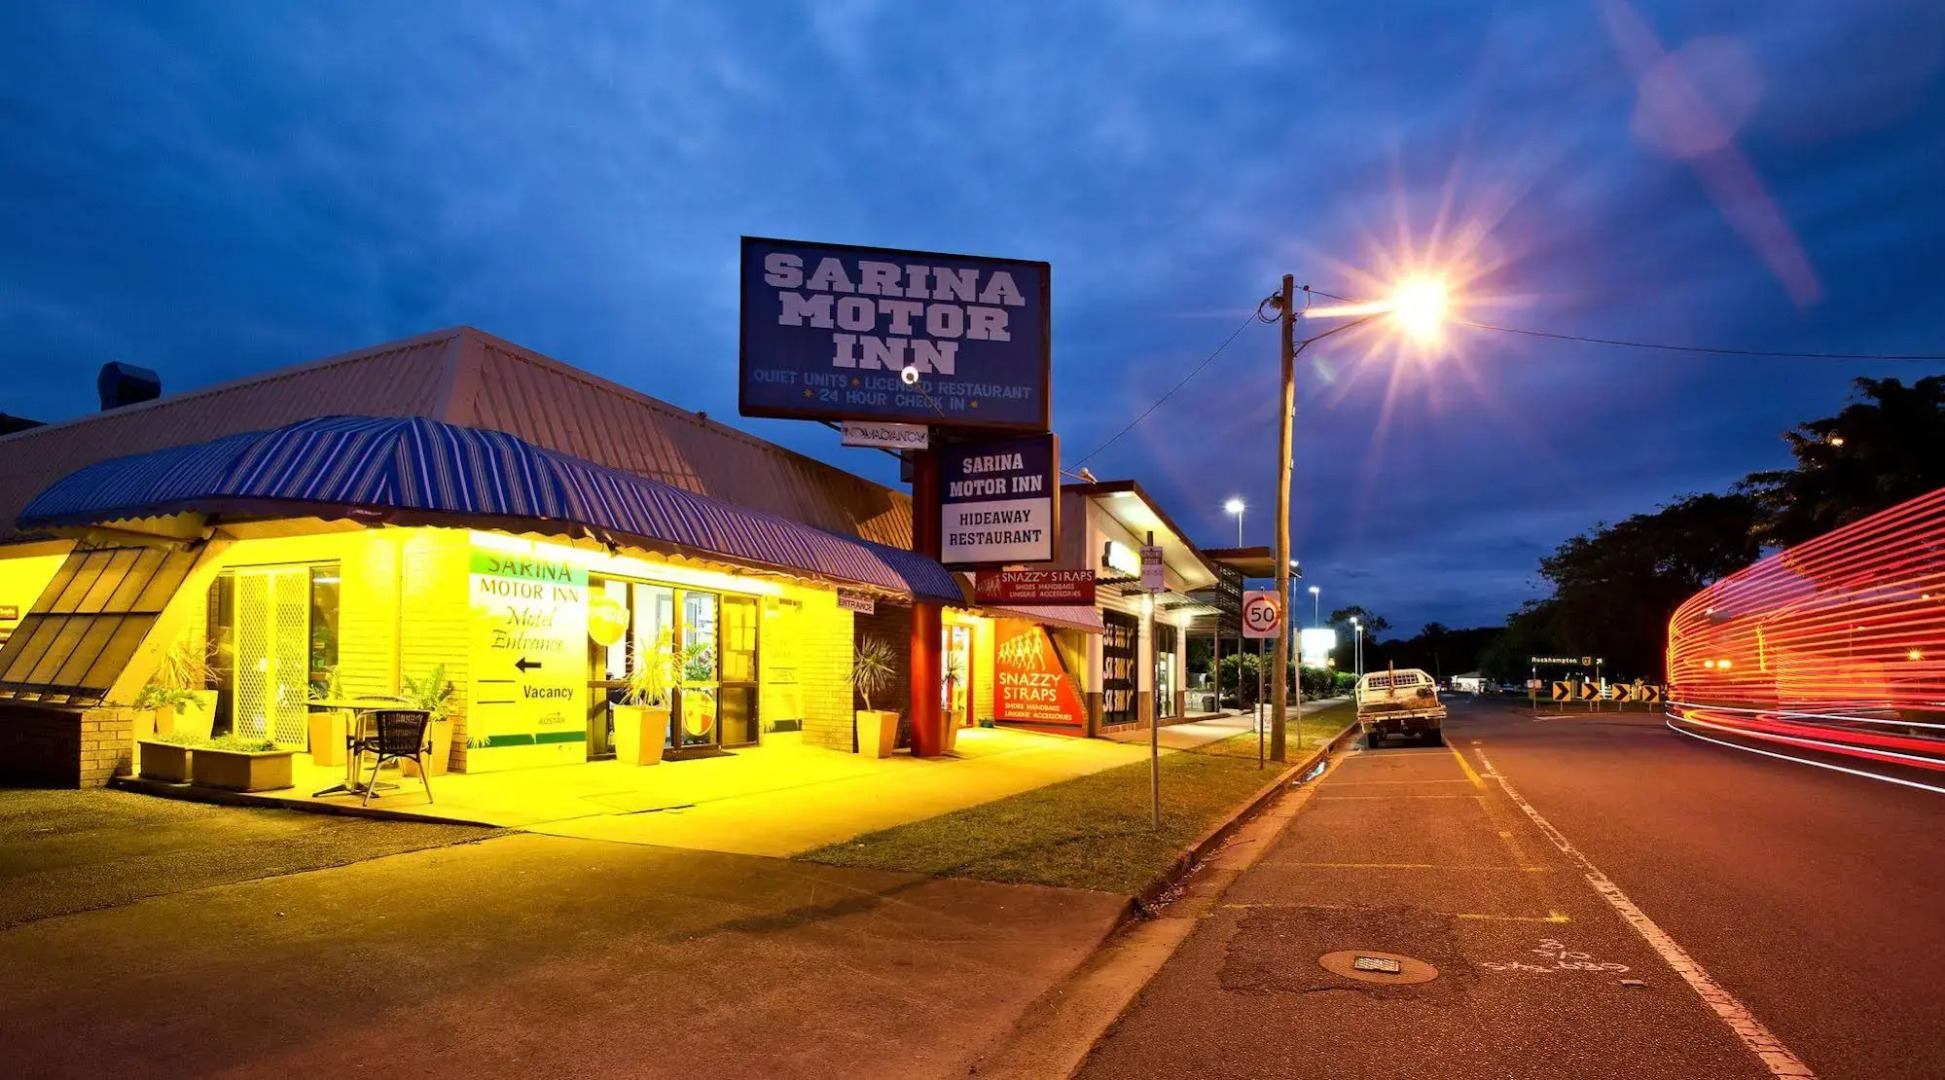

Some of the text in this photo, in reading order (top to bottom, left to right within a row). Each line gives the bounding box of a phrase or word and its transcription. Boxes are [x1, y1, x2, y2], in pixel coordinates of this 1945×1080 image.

[763, 252, 1026, 307] SARINA
[778, 290, 1011, 342] MOTOR
[832, 333, 959, 376] INN
[753, 369, 798, 386] QUIET
[804, 372, 848, 388] UNITS
[938, 381, 1032, 400] RESTAURANT
[819, 387, 965, 411] 24 HOUR CHECK IN
[962, 452, 1024, 475] SARINA
[949, 474, 1043, 498] MOTOR INN
[959, 509, 1031, 526] HIDEAWAY
[949, 529, 1042, 546] RESTAURANT
[487, 556, 573, 582] SARINA
[1001, 571, 1093, 583] SNAZZY STRAPS
[480, 578, 580, 603] MOTOR INN
[838, 598, 873, 612] ENTRANCE
[1250, 607, 1275, 623] 50
[507, 605, 558, 628] Motel
[491, 628, 565, 651] Entrance
[1531, 656, 1577, 664] Rockhampton
[998, 672, 1063, 688] SNAZZY
[523, 684, 574, 701] Vacancy
[1003, 687, 1057, 702] STRAPS
[1004, 702, 1061, 712] SHOES HANDBAGS
[538, 716, 566, 726] AUSTAR
